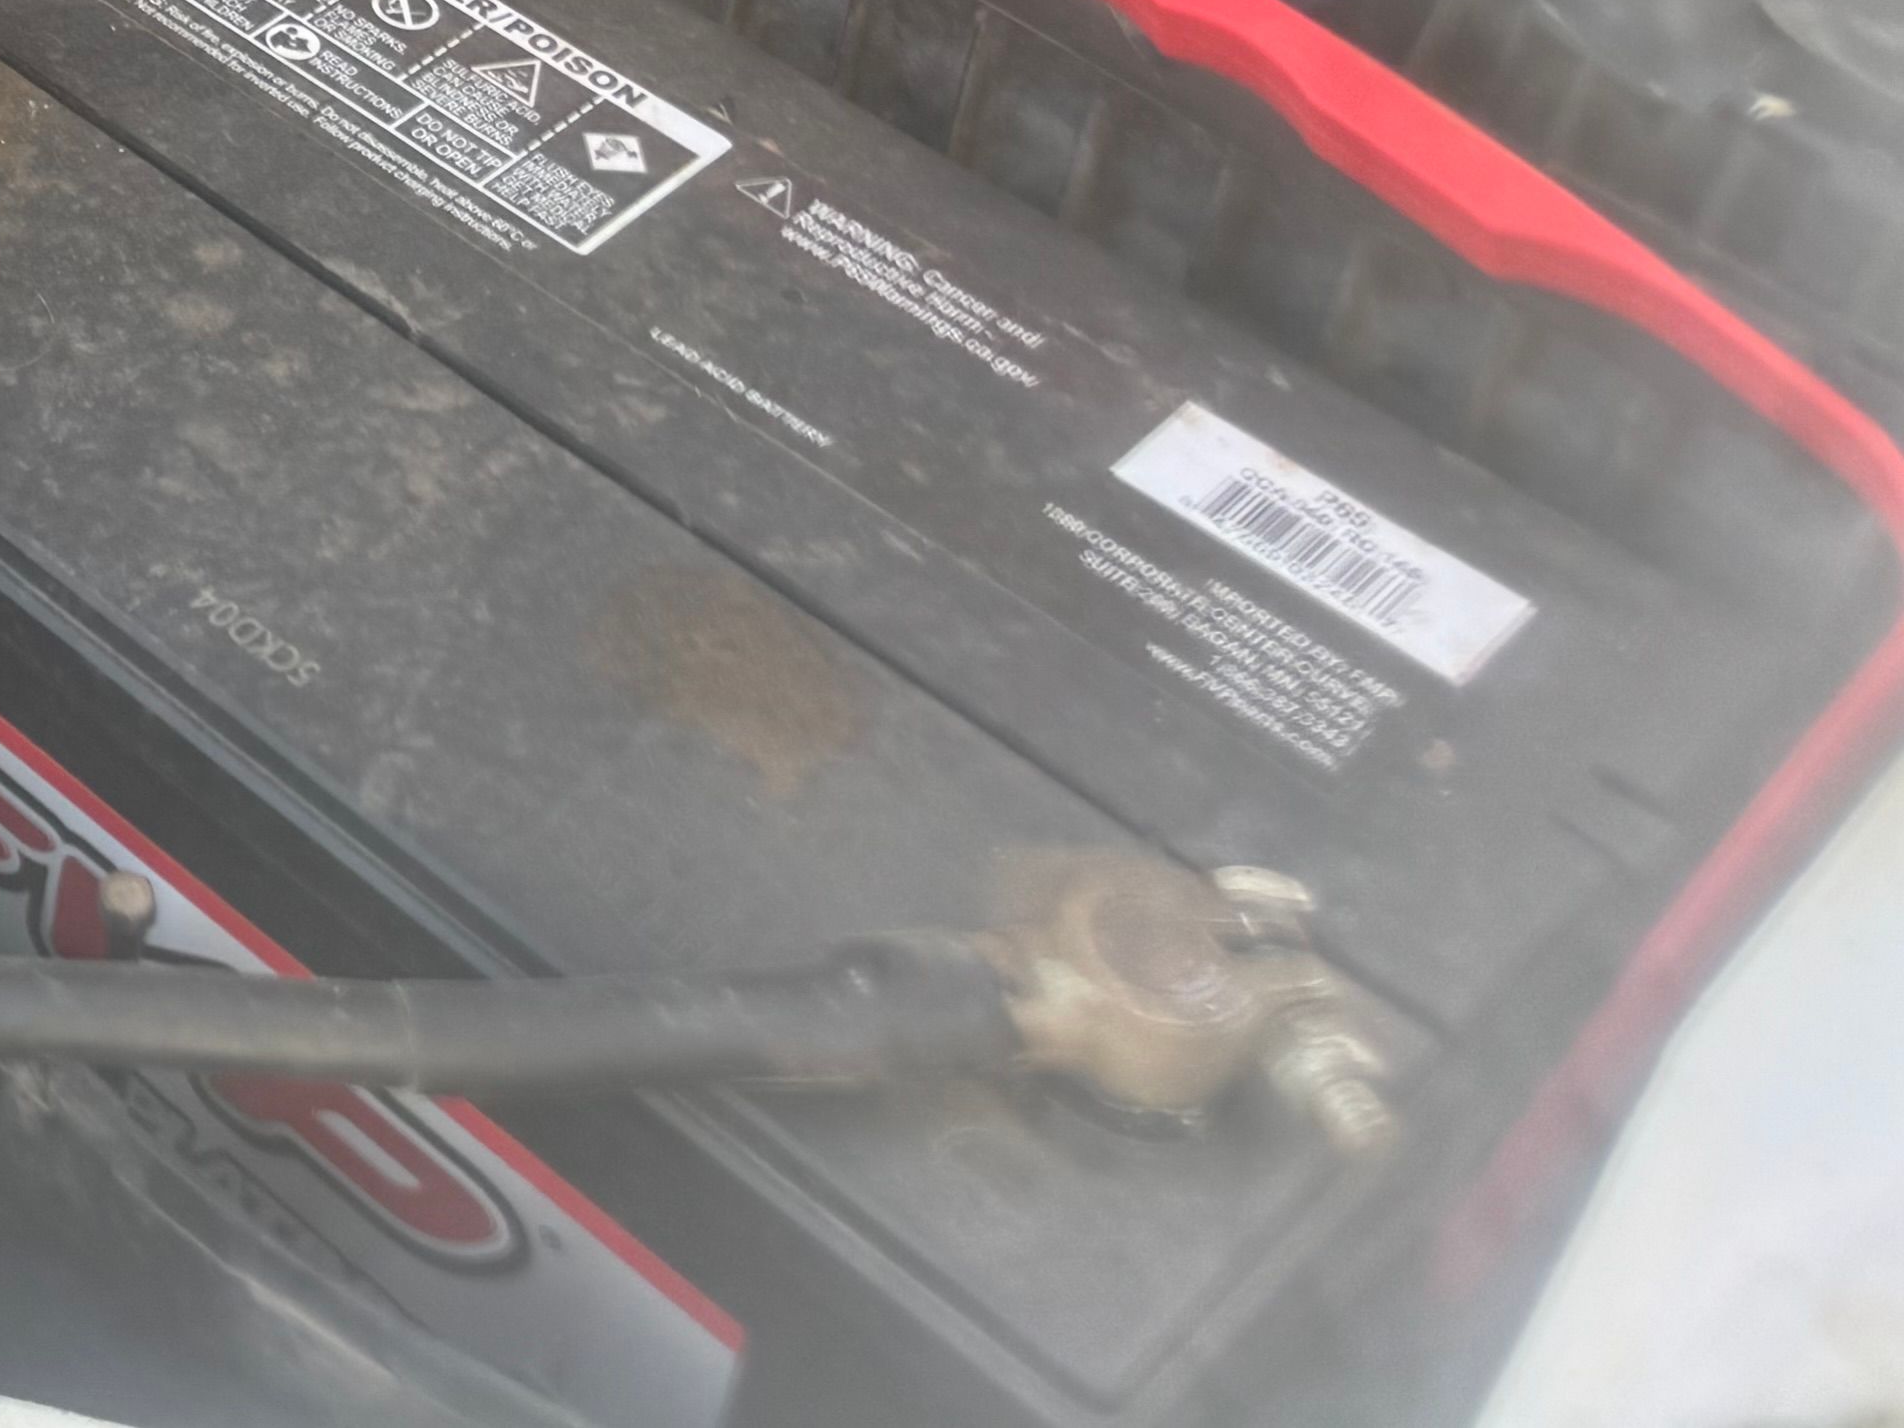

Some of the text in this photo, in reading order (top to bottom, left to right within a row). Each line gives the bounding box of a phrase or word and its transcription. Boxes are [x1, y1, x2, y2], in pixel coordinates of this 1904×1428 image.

[321, 10, 377, 46] FLAMES
[330, 4, 357, 21] NO
[312, 17, 397, 71] OR SMOKING
[317, 49, 359, 76] READ
[306, 56, 405, 120] INSTRUCTIONS
[408, 78, 467, 116] SEVERE
[419, 72, 499, 123] BLINDNESS
[430, 66, 510, 117] CAN CAUSE
[438, 57, 511, 104] SULFURIC
[151, 10, 230, 64] recommended
[225, 59, 248, 74] for
[242, 70, 290, 103] inverted
[311, 115, 353, 144] Follow
[346, 139, 397, 174] product
[390, 168, 447, 208] charging
[163, 5, 193, 24] Risk
[217, 41, 275, 80] explosion
[336, 117, 361, 134] not
[453, 194, 494, 223] above
[407, 126, 439, 147] OR
[414, 112, 503, 170] DO NOT TIP
[488, 180, 531, 208] HELP
[511, 167, 549, 192] WITH
[519, 159, 612, 219] IMMEDIATELY
[529, 152, 580, 185] FLUSH
[499, 173, 594, 235] GET MEDICAL
[1075, 547, 1143, 593] SUITE
[190, 585, 321, 687] 5CKD04
[1206, 605, 1295, 664] CENTER
